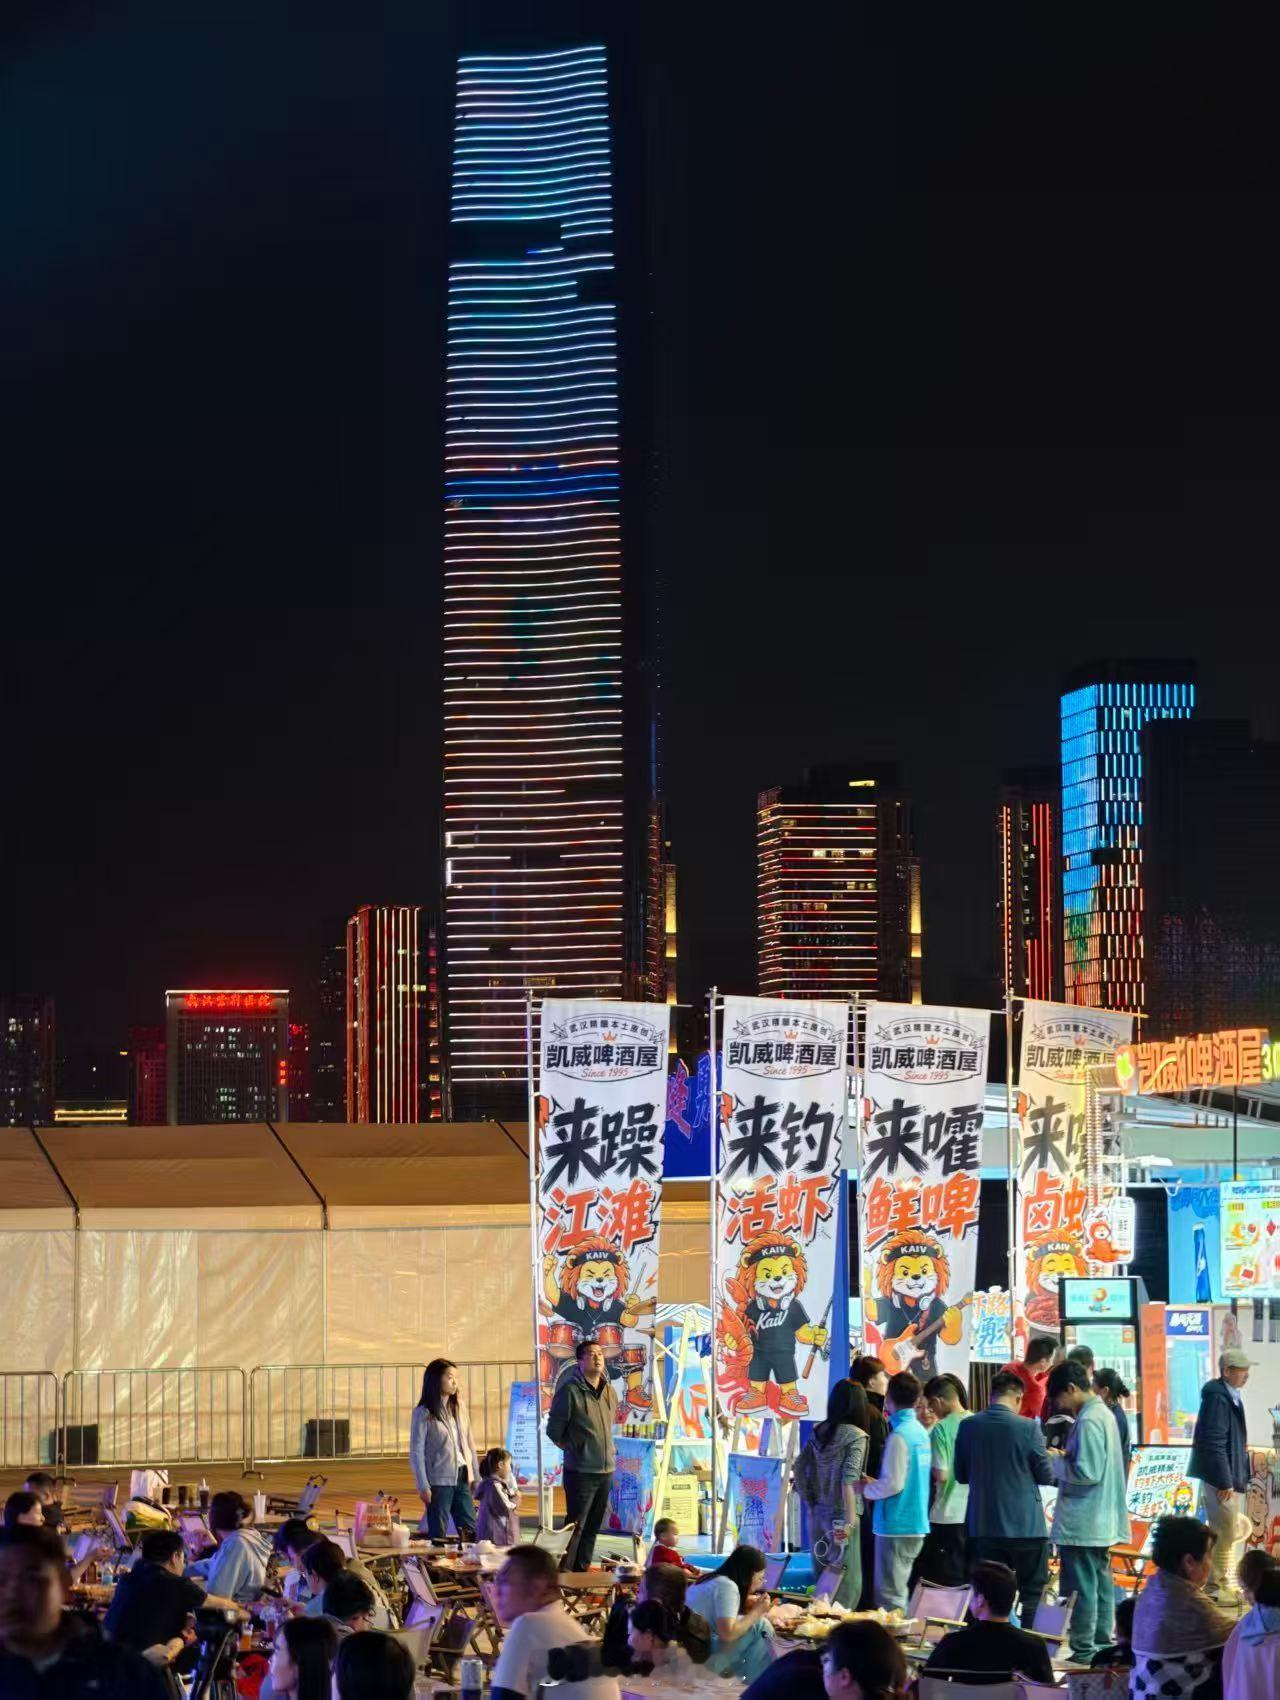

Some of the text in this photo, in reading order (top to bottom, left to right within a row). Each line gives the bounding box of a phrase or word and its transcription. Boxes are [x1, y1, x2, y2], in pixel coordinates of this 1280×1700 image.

[546, 1044, 659, 1068] 凯威啤酒屋
[728, 1041, 837, 1066] 凯威啤酒屋
[871, 1046, 978, 1072] 凯威啤酒屋
[1137, 1028, 1262, 1095] 凯威啤酒屋
[581, 1068, 605, 1078] Since
[763, 1065, 808, 1075] Since 1995
[904, 1071, 950, 1080] Since 1995
[542, 1097, 660, 1194] 来躁
[724, 1095, 835, 1182] 来钓
[862, 1098, 984, 1183] 来嚯
[543, 1178, 653, 1254] 江滩
[726, 1174, 832, 1242] 活虾
[865, 1172, 980, 1248] 鲜啤
[585, 1251, 609, 1261] KAIV
[761, 1246, 787, 1256] KAIV
[900, 1246, 928, 1255] KAIV
[1048, 1243, 1070, 1252] KAIV
